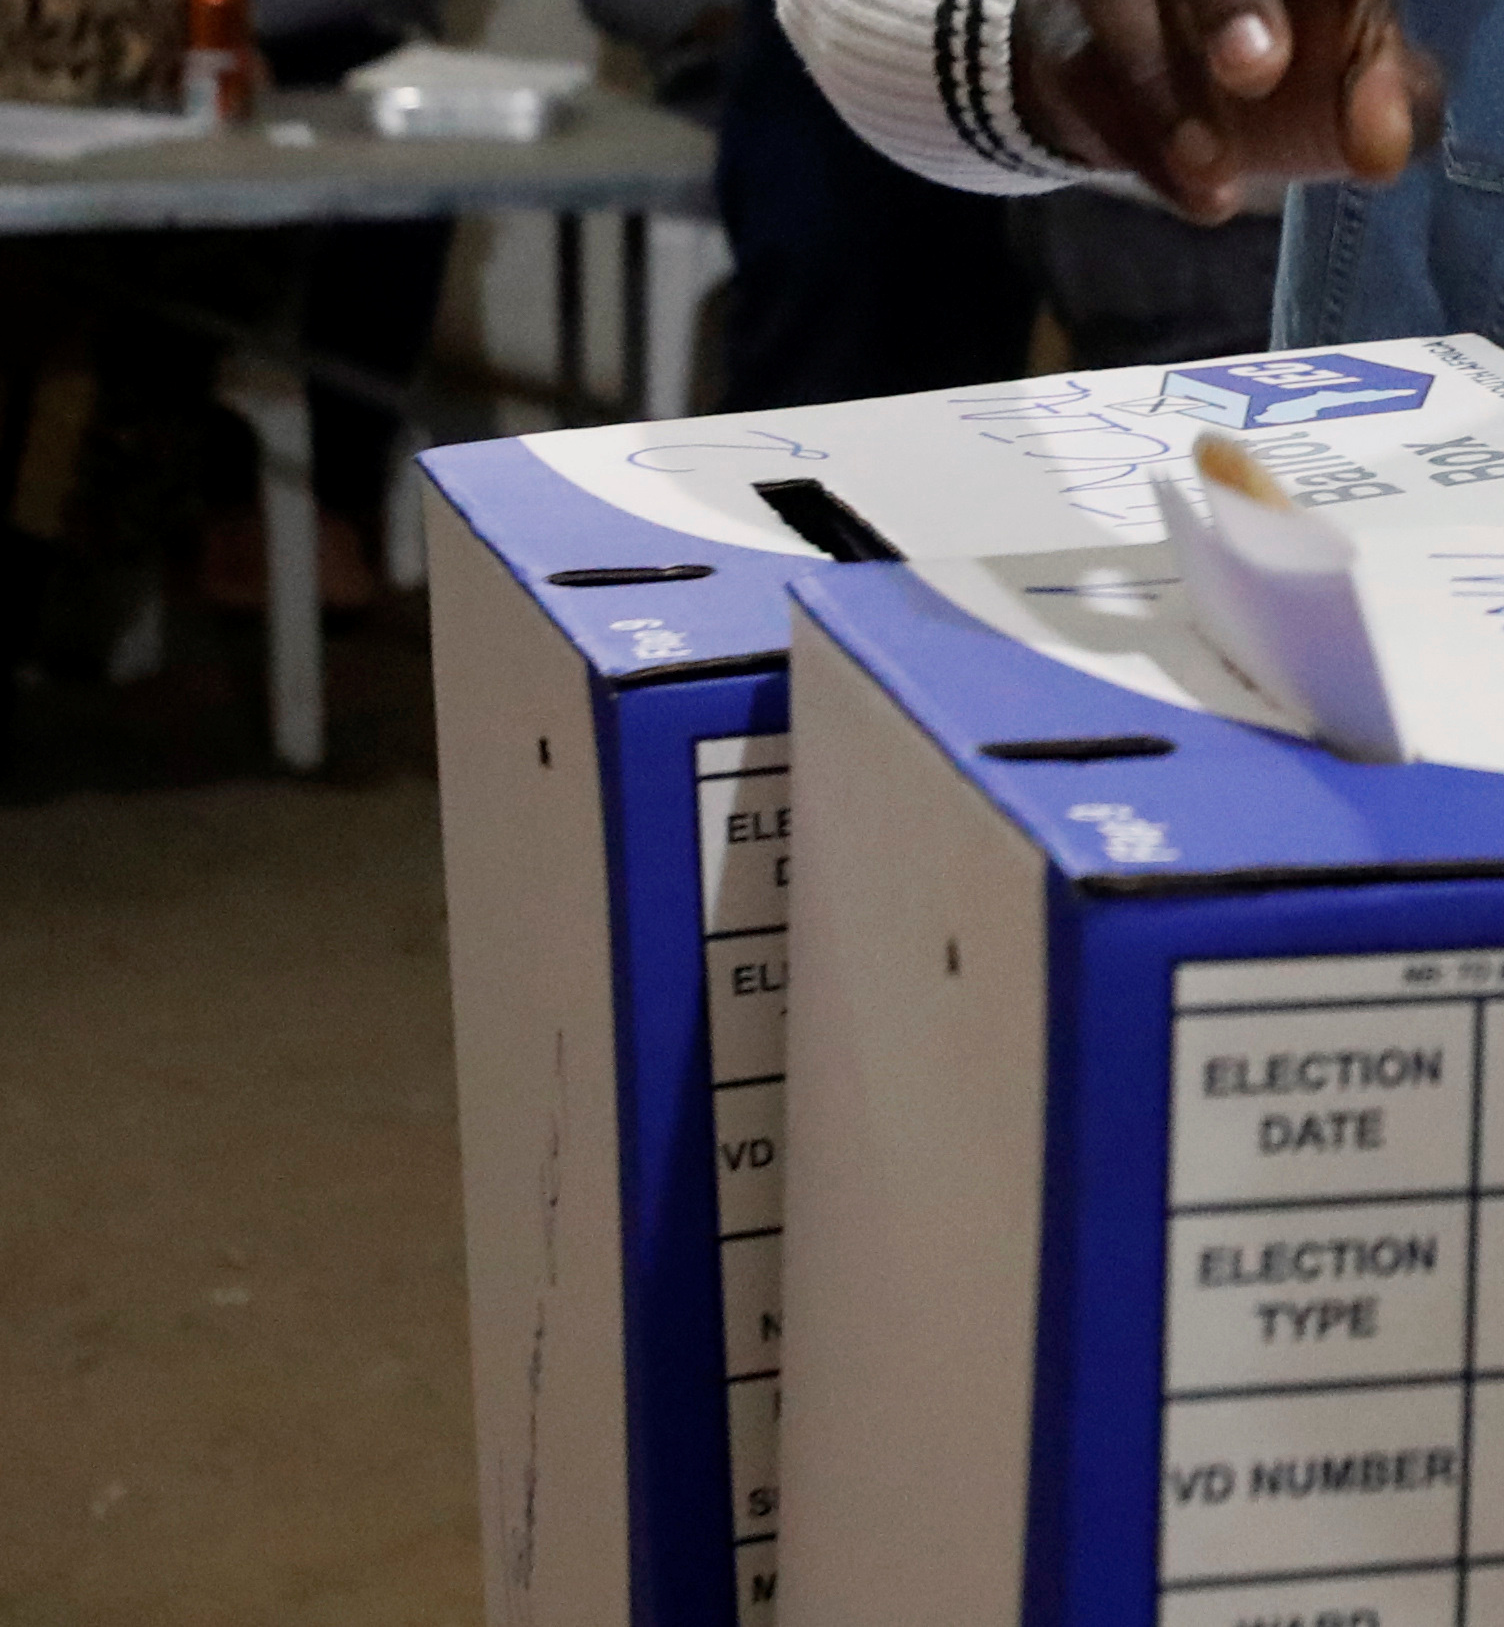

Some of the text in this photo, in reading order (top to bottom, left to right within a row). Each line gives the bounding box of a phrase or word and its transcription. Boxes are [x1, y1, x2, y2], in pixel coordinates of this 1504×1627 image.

[1227, 361, 1362, 390] IEC
[1203, 1045, 1444, 1098] ELECTION
[721, 1137, 775, 1172] VD
[1257, 1107, 1386, 1156] DATE
[1198, 1234, 1438, 1289] ELECTION
[1255, 1296, 1379, 1344] TYPE
[1170, 1446, 1460, 1507] VD NUMBER
